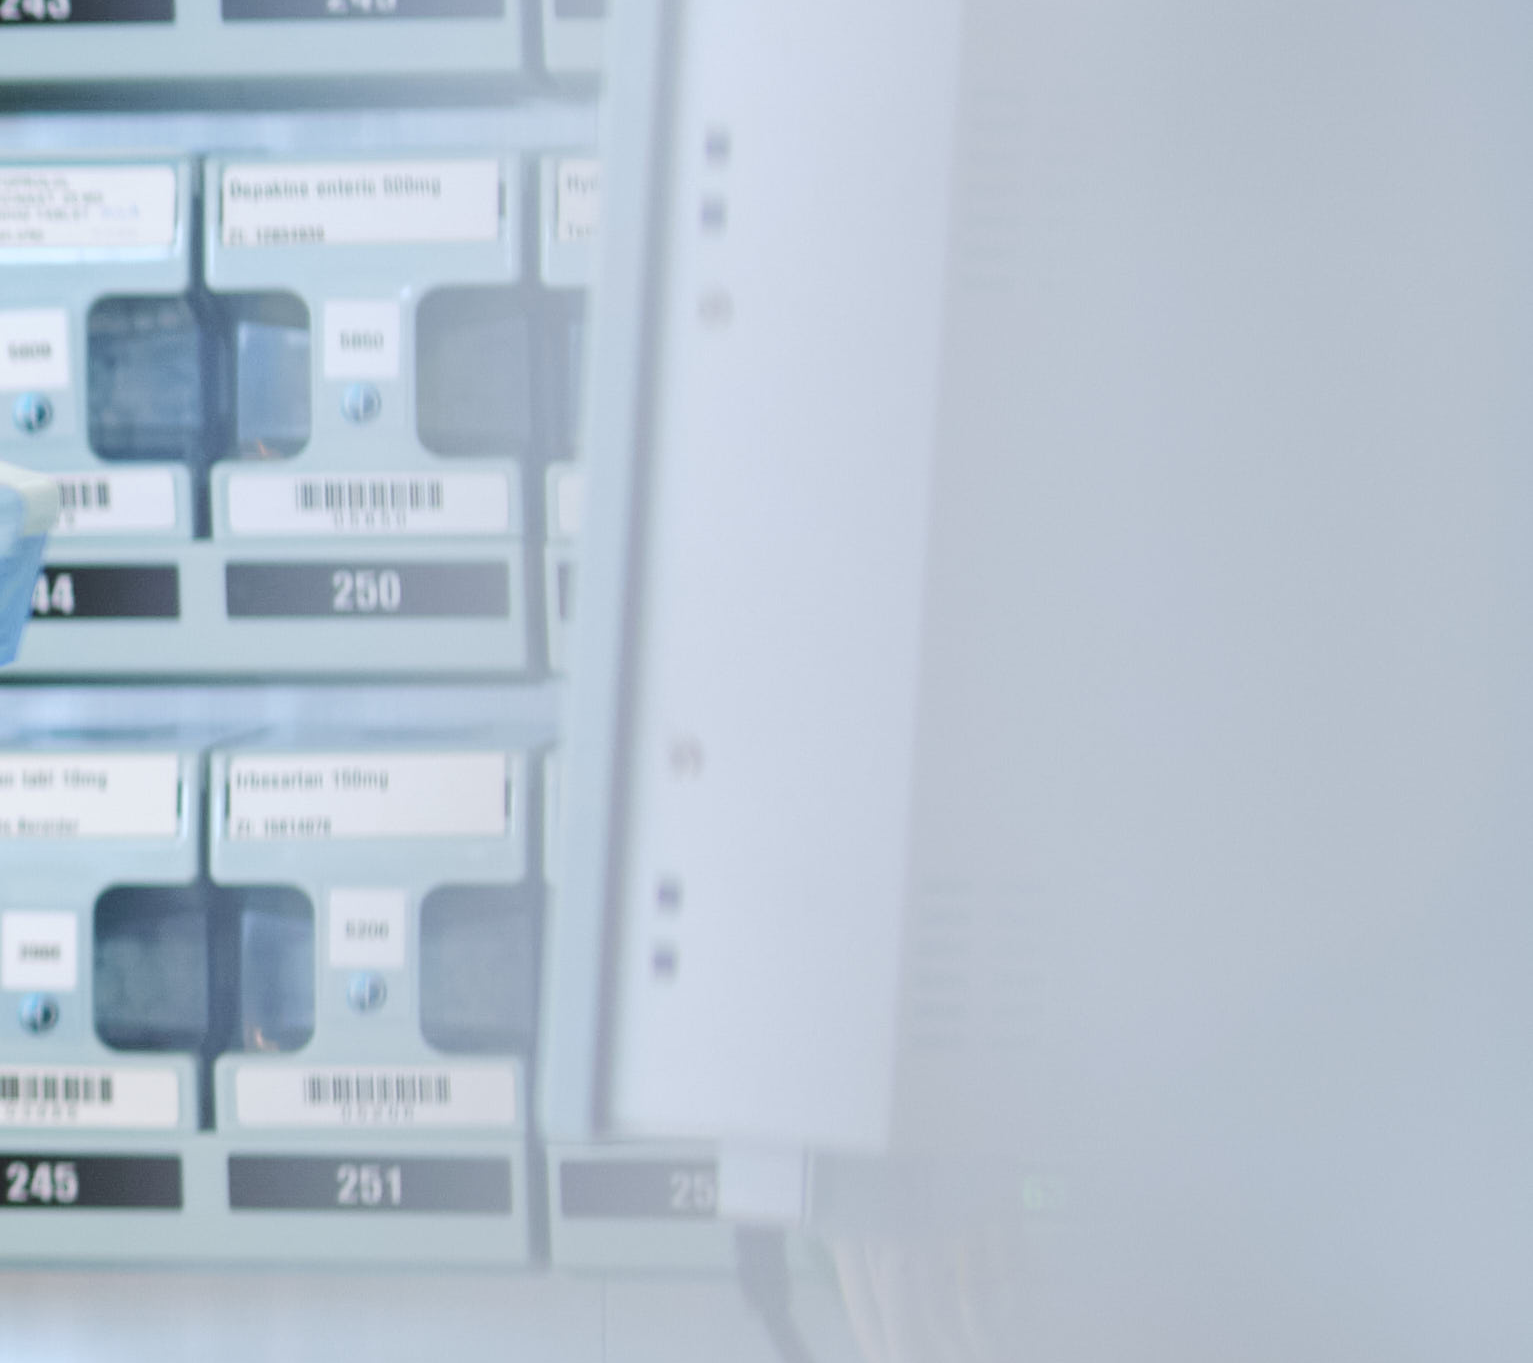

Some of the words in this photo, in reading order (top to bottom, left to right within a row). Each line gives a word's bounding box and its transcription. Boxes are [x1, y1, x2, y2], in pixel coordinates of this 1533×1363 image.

[229, 179, 309, 202] Depakine
[30, 572, 76, 615] 44
[331, 568, 403, 613] 250
[237, 771, 324, 791] Irbesartan
[5, 1161, 81, 1205] 245
[335, 1163, 404, 1206] 251
[669, 1170, 716, 1212] 25
